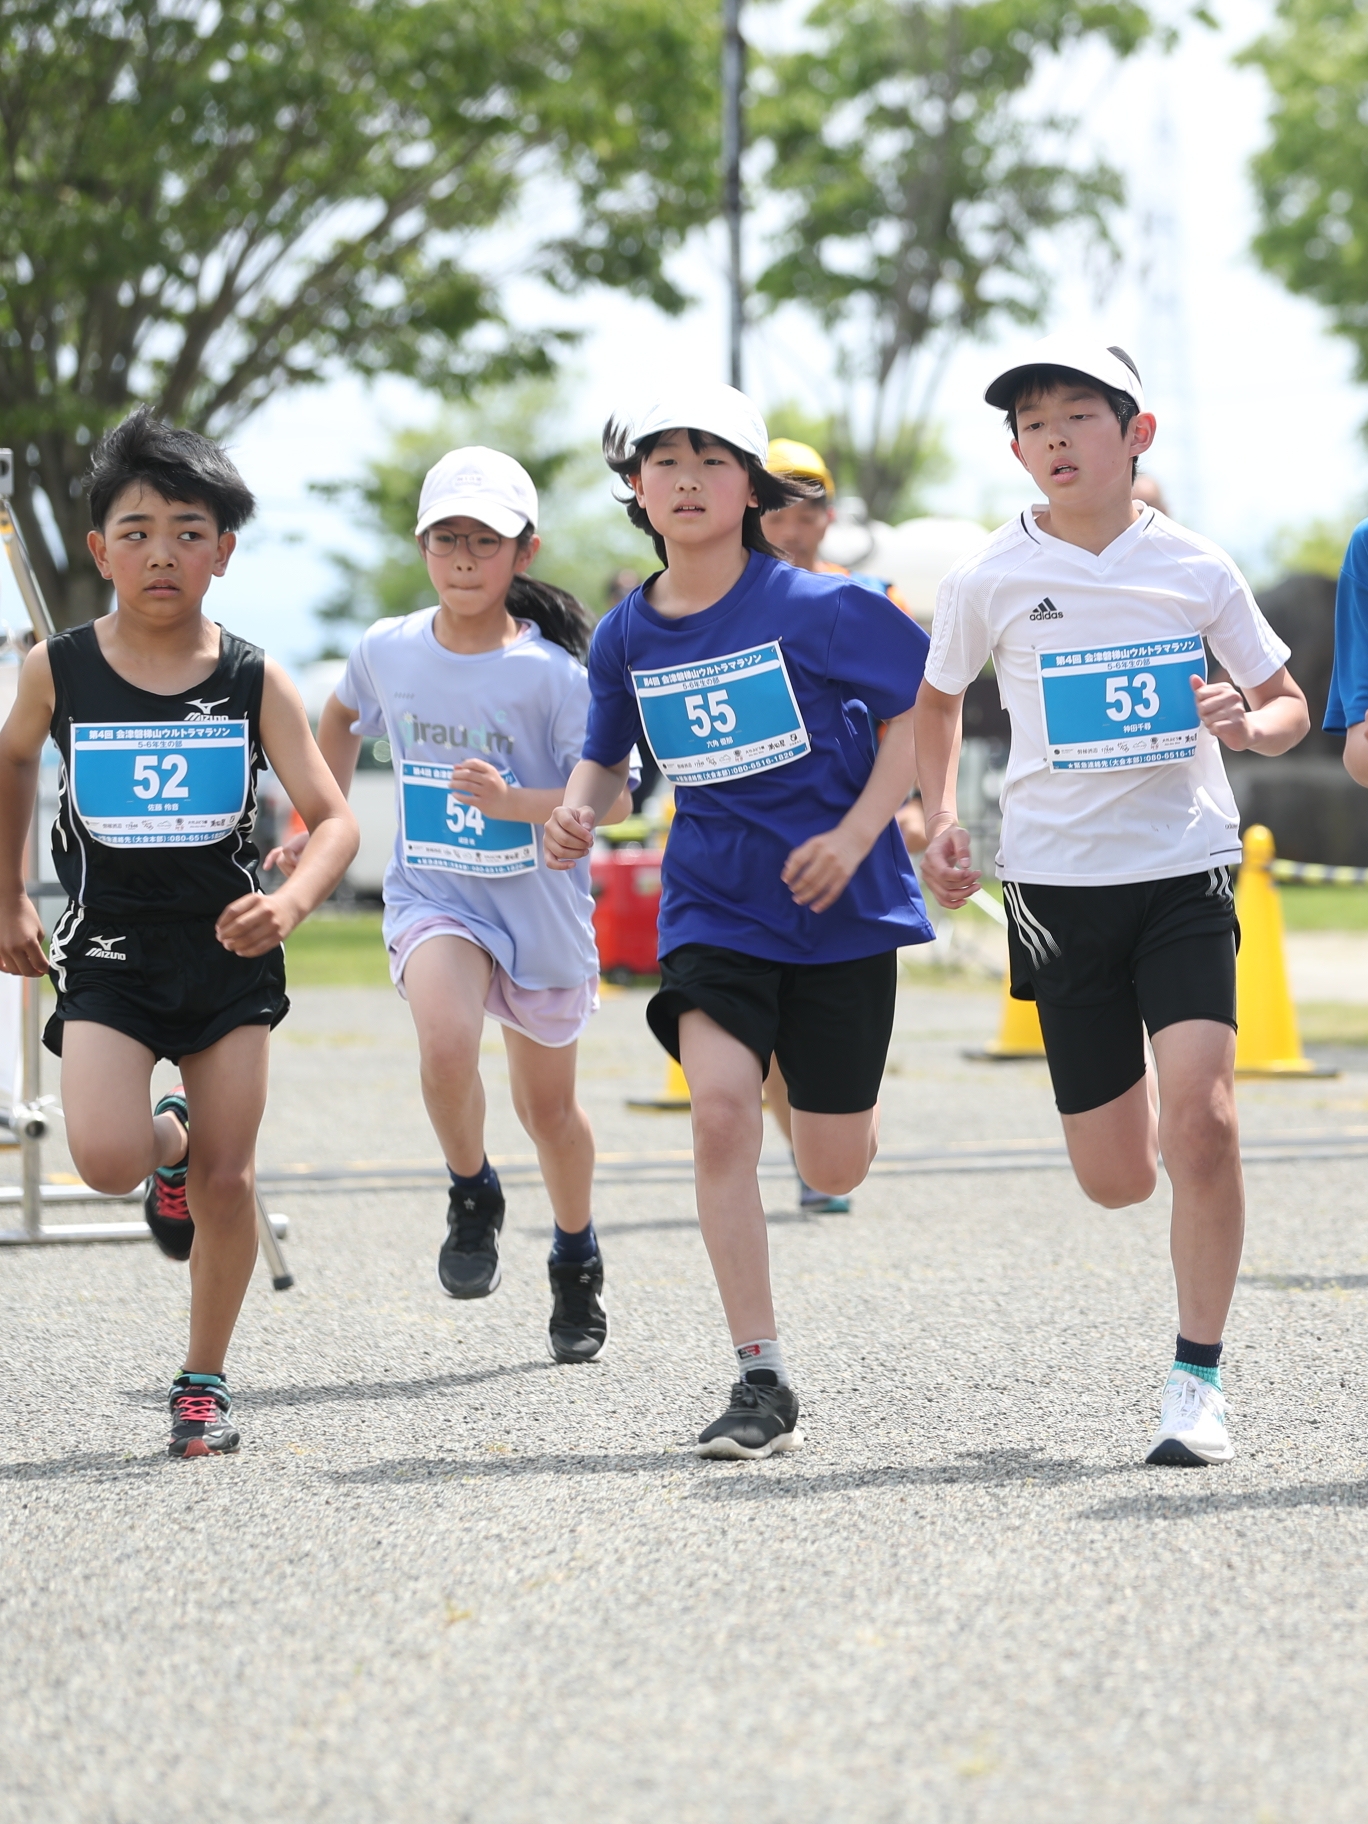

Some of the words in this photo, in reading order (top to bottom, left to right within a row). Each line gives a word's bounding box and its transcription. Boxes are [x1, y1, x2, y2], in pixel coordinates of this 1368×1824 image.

[1029, 611, 1064, 621] adidas
[1056, 654, 1082, 666] 第4回
[1084, 641, 1195, 664] 会津磐梯山ウルトラマラソン
[661, 654, 762, 684] 会津磐梯山ウルトラマラソン
[1107, 658, 1151, 671] 5-6年生の部
[682, 676, 721, 690] 5-6年生の部
[1105, 672, 1160, 722] 53
[684, 689, 737, 738] 55
[89, 730, 114, 740] 第4回
[116, 728, 230, 739] 会津磐梯山ウルトラマラソン
[138, 740, 183, 749] 5-6年生の部
[706, 739, 720, 749] 六角
[132, 754, 189, 800] 52
[147, 803, 162, 812] 佐藤
[446, 793, 485, 835] 54
[85, 947, 126, 961] MIZUNO
